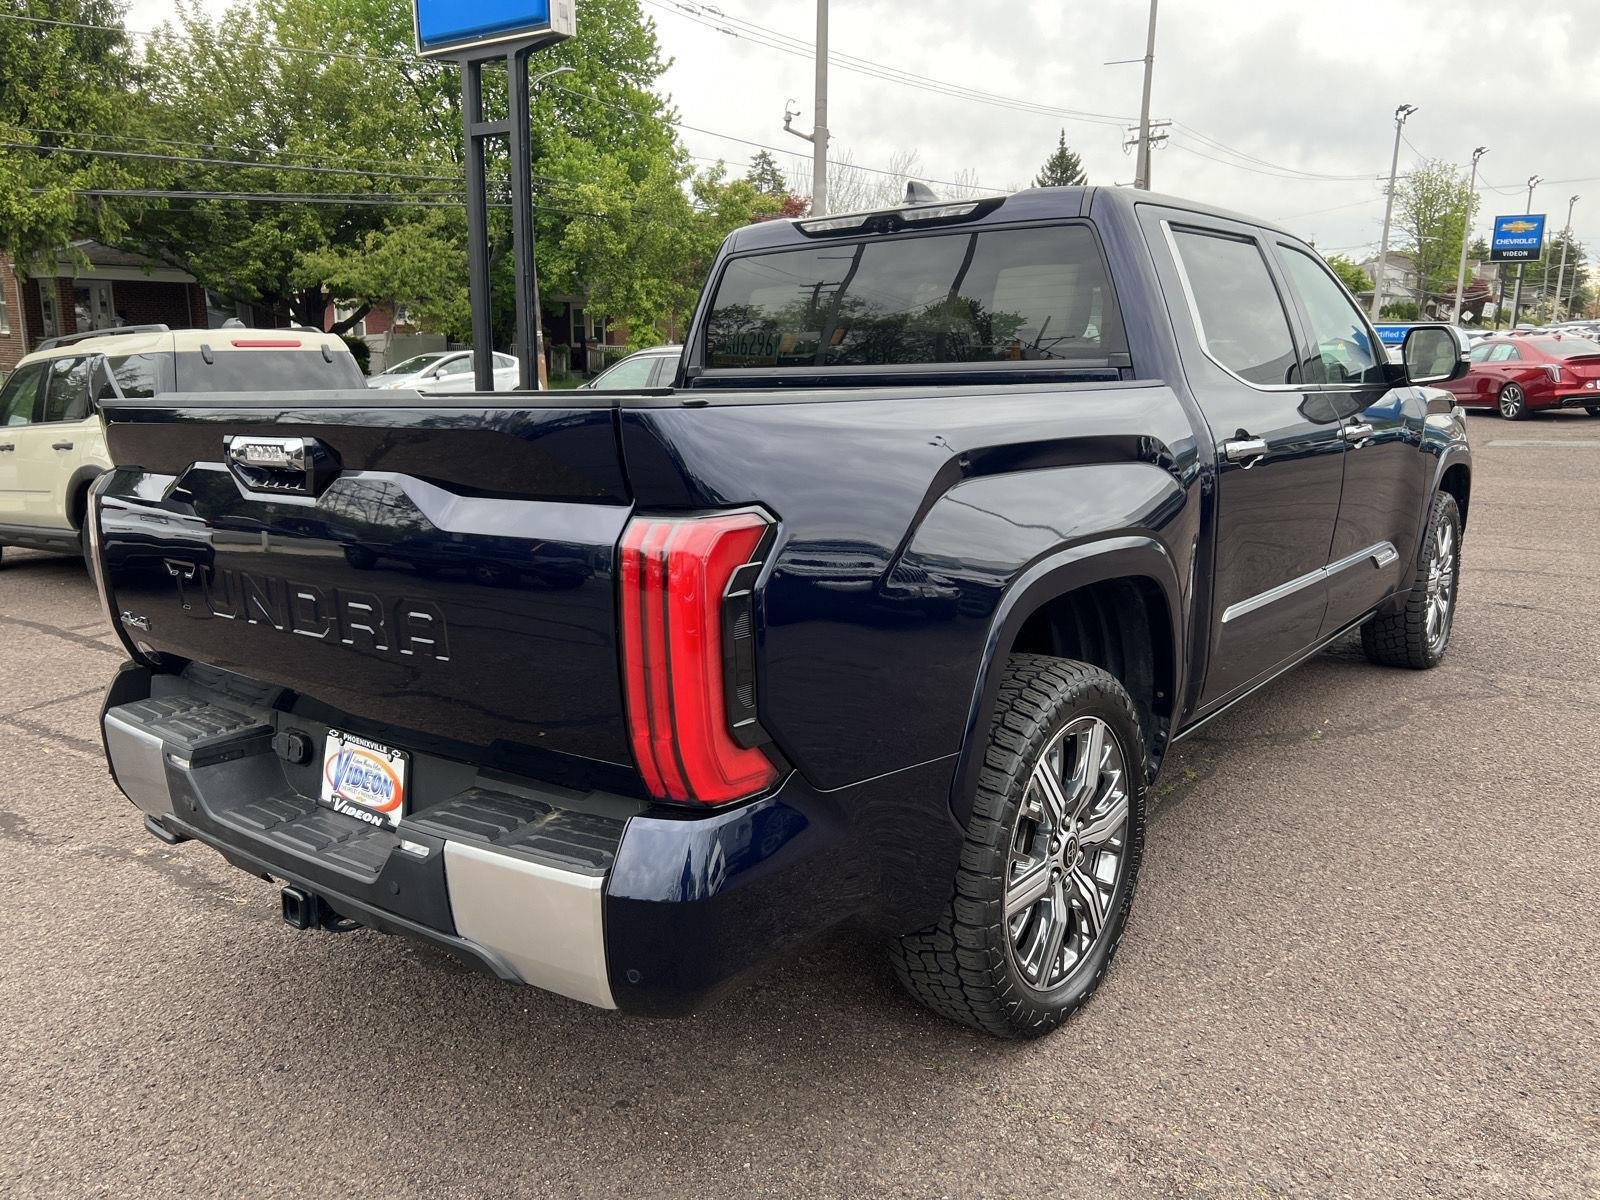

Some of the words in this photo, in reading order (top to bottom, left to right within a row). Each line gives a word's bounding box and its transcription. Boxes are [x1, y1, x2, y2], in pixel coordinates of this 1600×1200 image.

[1496, 237, 1537, 245] CHEVROLET
[163, 558, 449, 662] TUNDRA
[343, 733, 388, 754] PHOENIXVILLE
[333, 745, 394, 800] VIDEON
[333, 797, 383, 827] VIDEON
